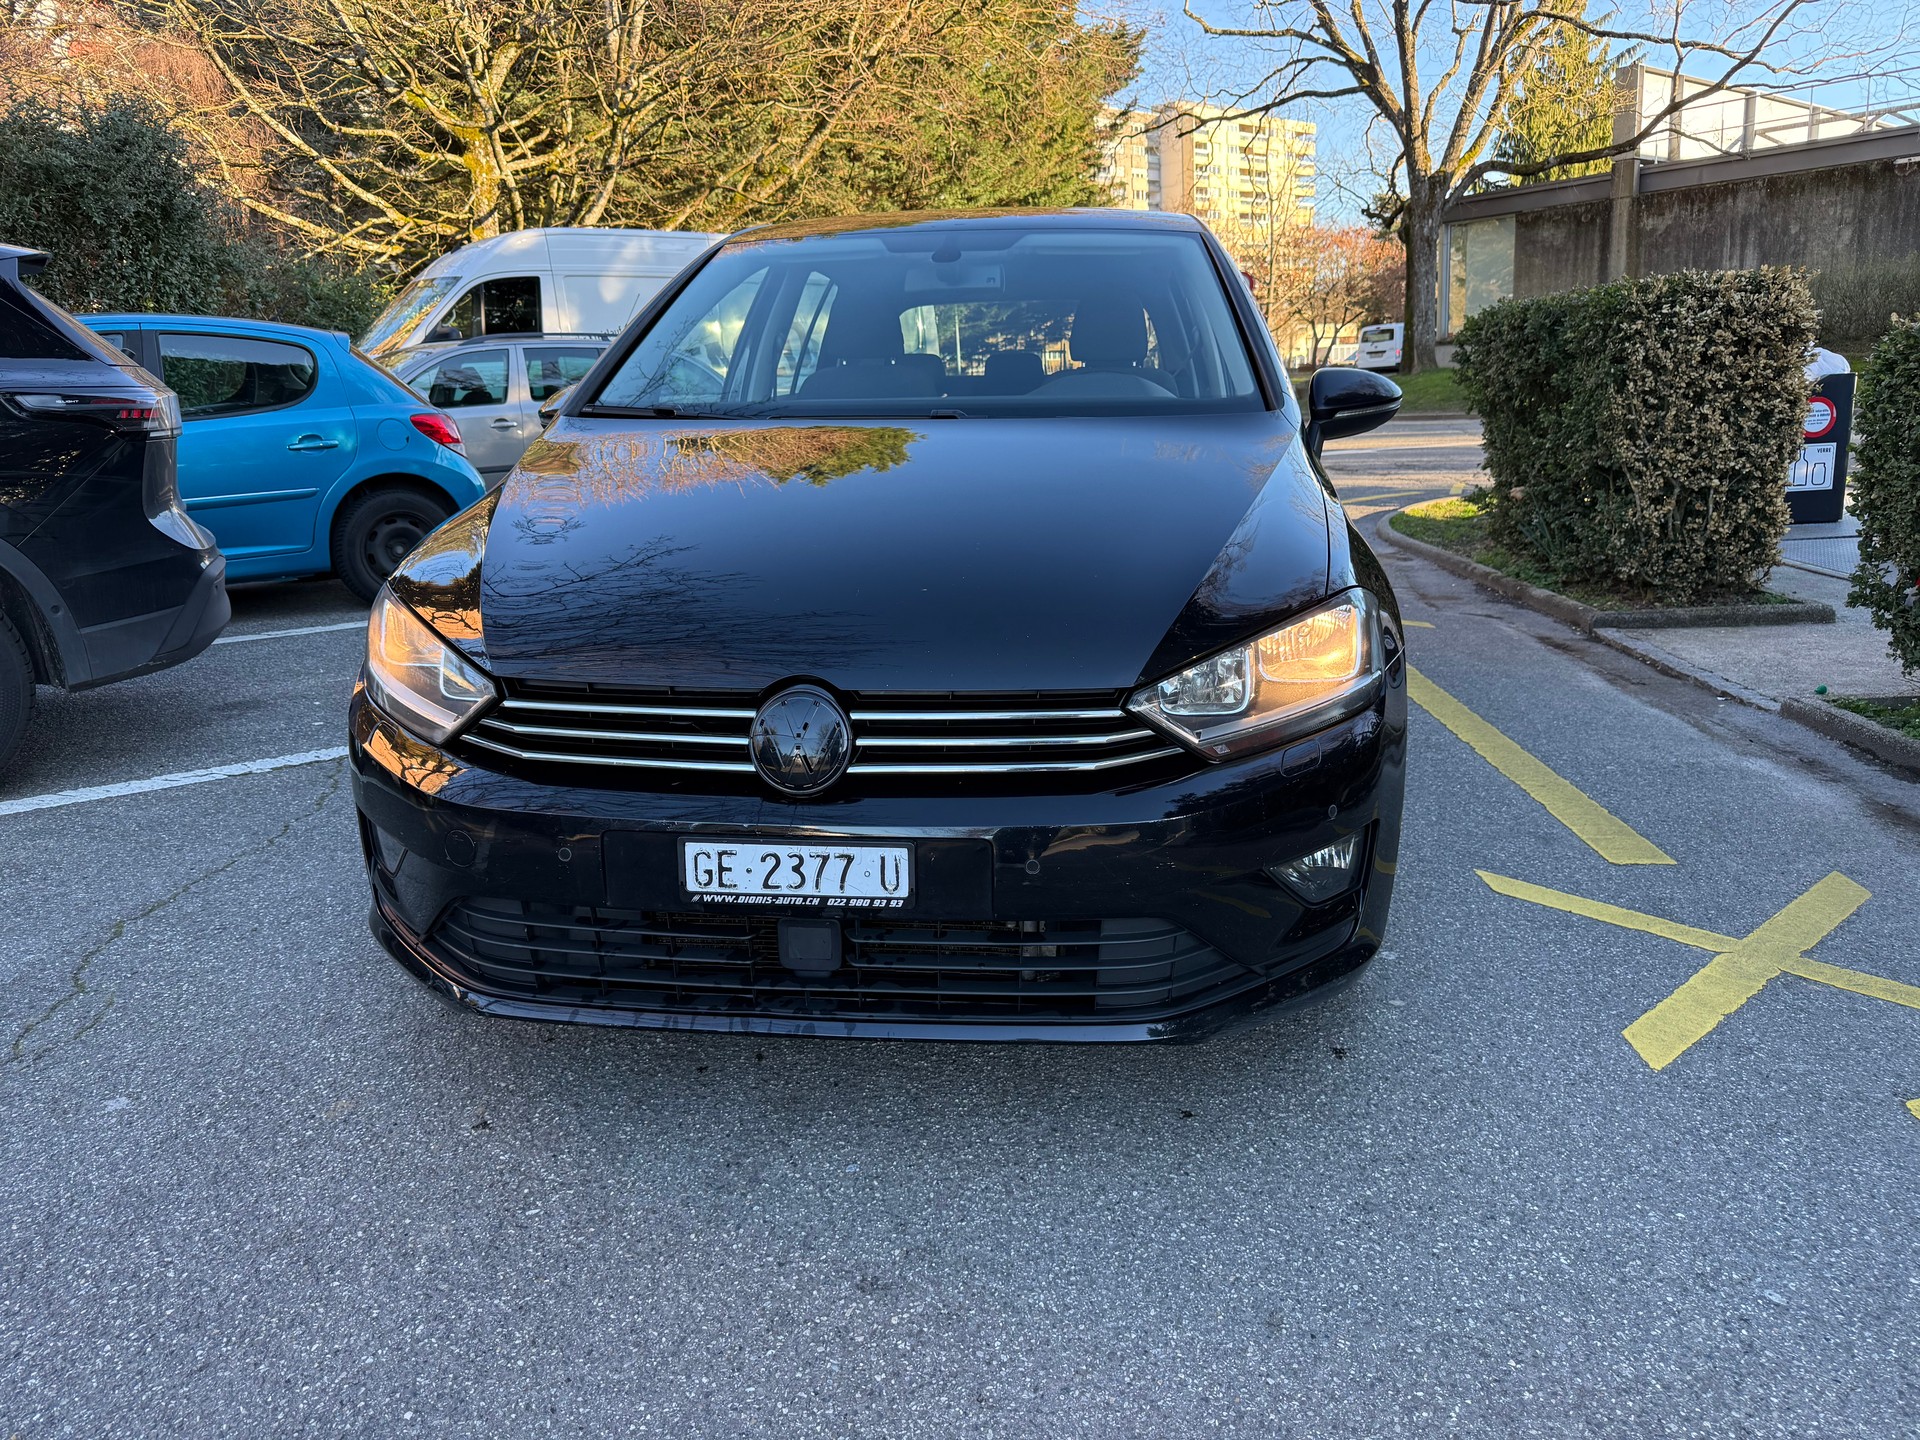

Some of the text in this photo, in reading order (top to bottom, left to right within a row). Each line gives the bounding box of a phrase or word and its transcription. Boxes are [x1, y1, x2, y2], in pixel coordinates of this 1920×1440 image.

[694, 849, 900, 894] GE 2377 U
[827, 898, 847, 906] 022
[848, 899, 871, 907] 980
[872, 899, 887, 907] 93
